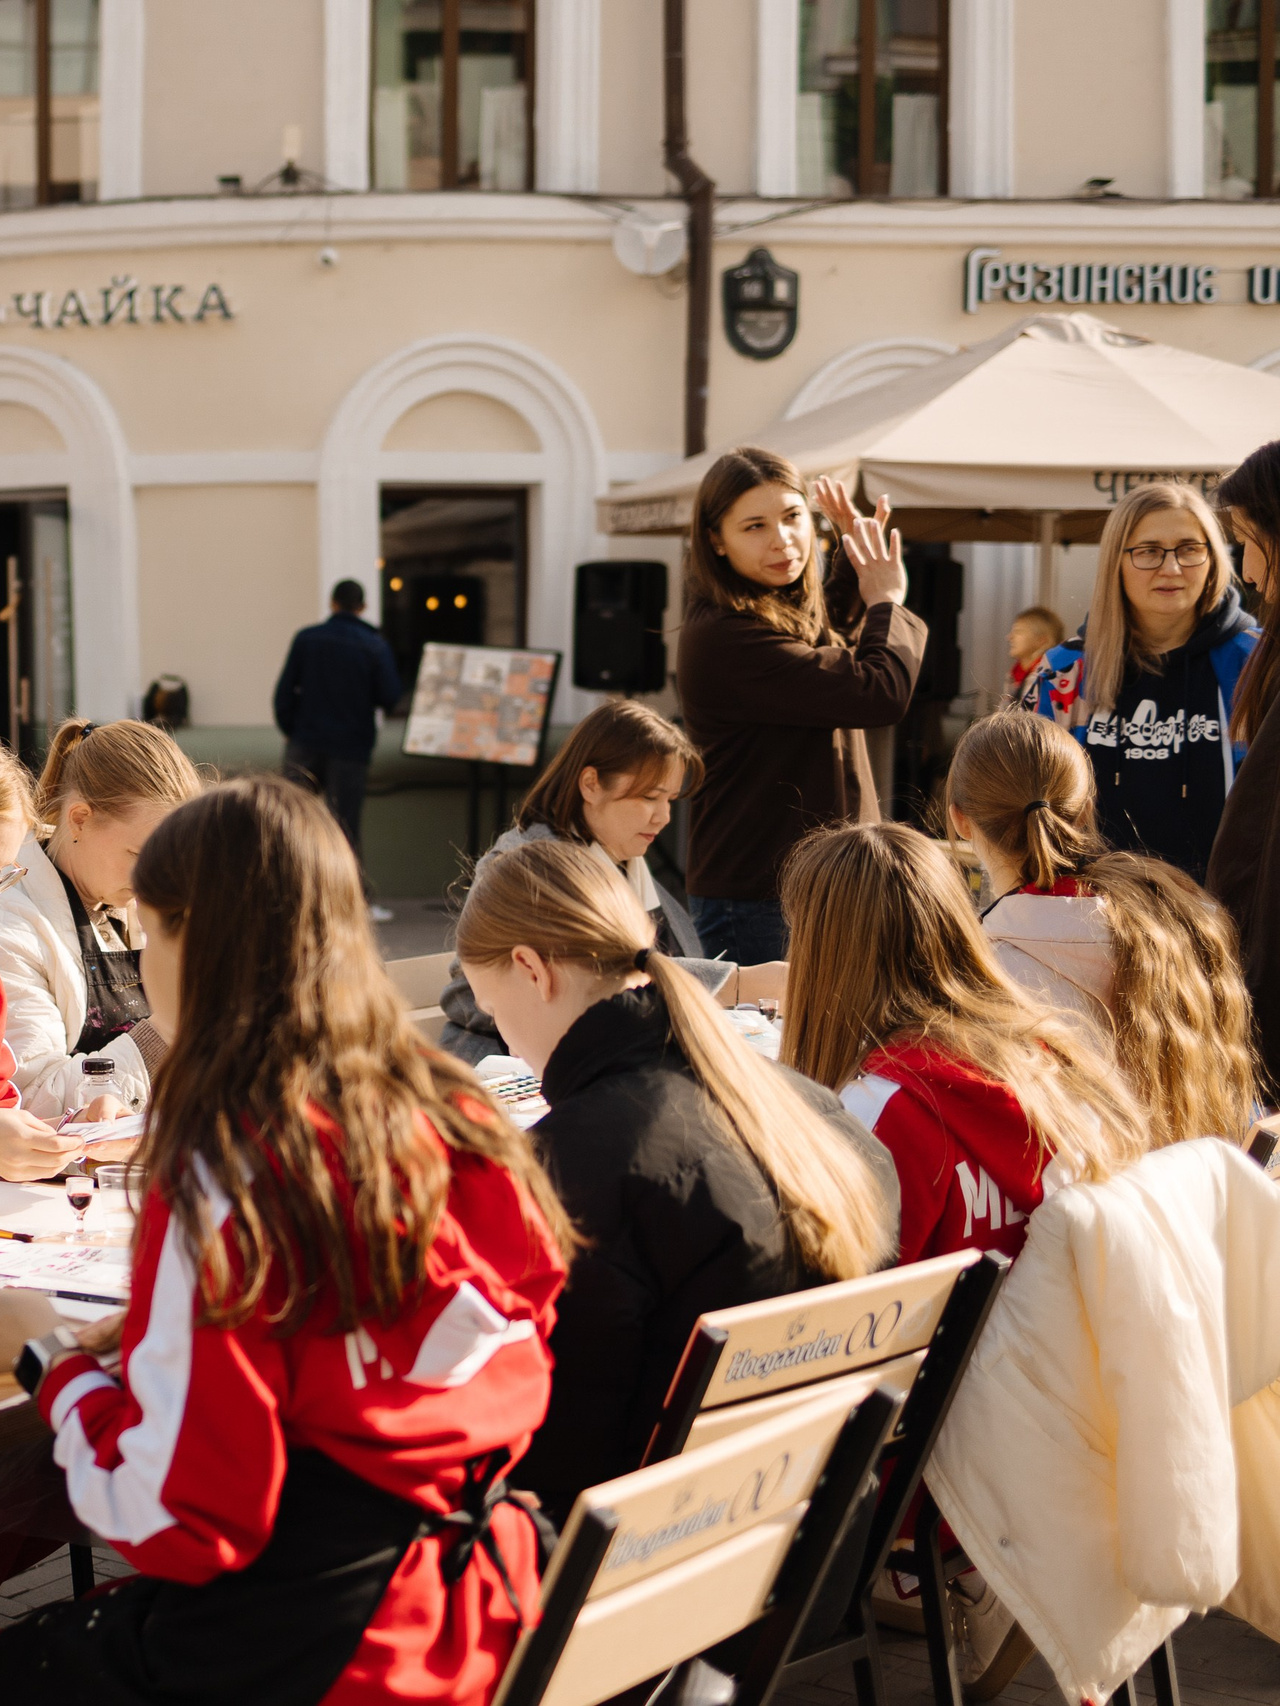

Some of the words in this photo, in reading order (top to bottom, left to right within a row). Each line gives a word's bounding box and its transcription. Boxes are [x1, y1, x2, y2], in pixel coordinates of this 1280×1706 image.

[12, 274, 235, 329] ЧАЙКА
[1124, 747, 1170, 760] 1908
[724, 1330, 844, 1384] Hoegaarden
